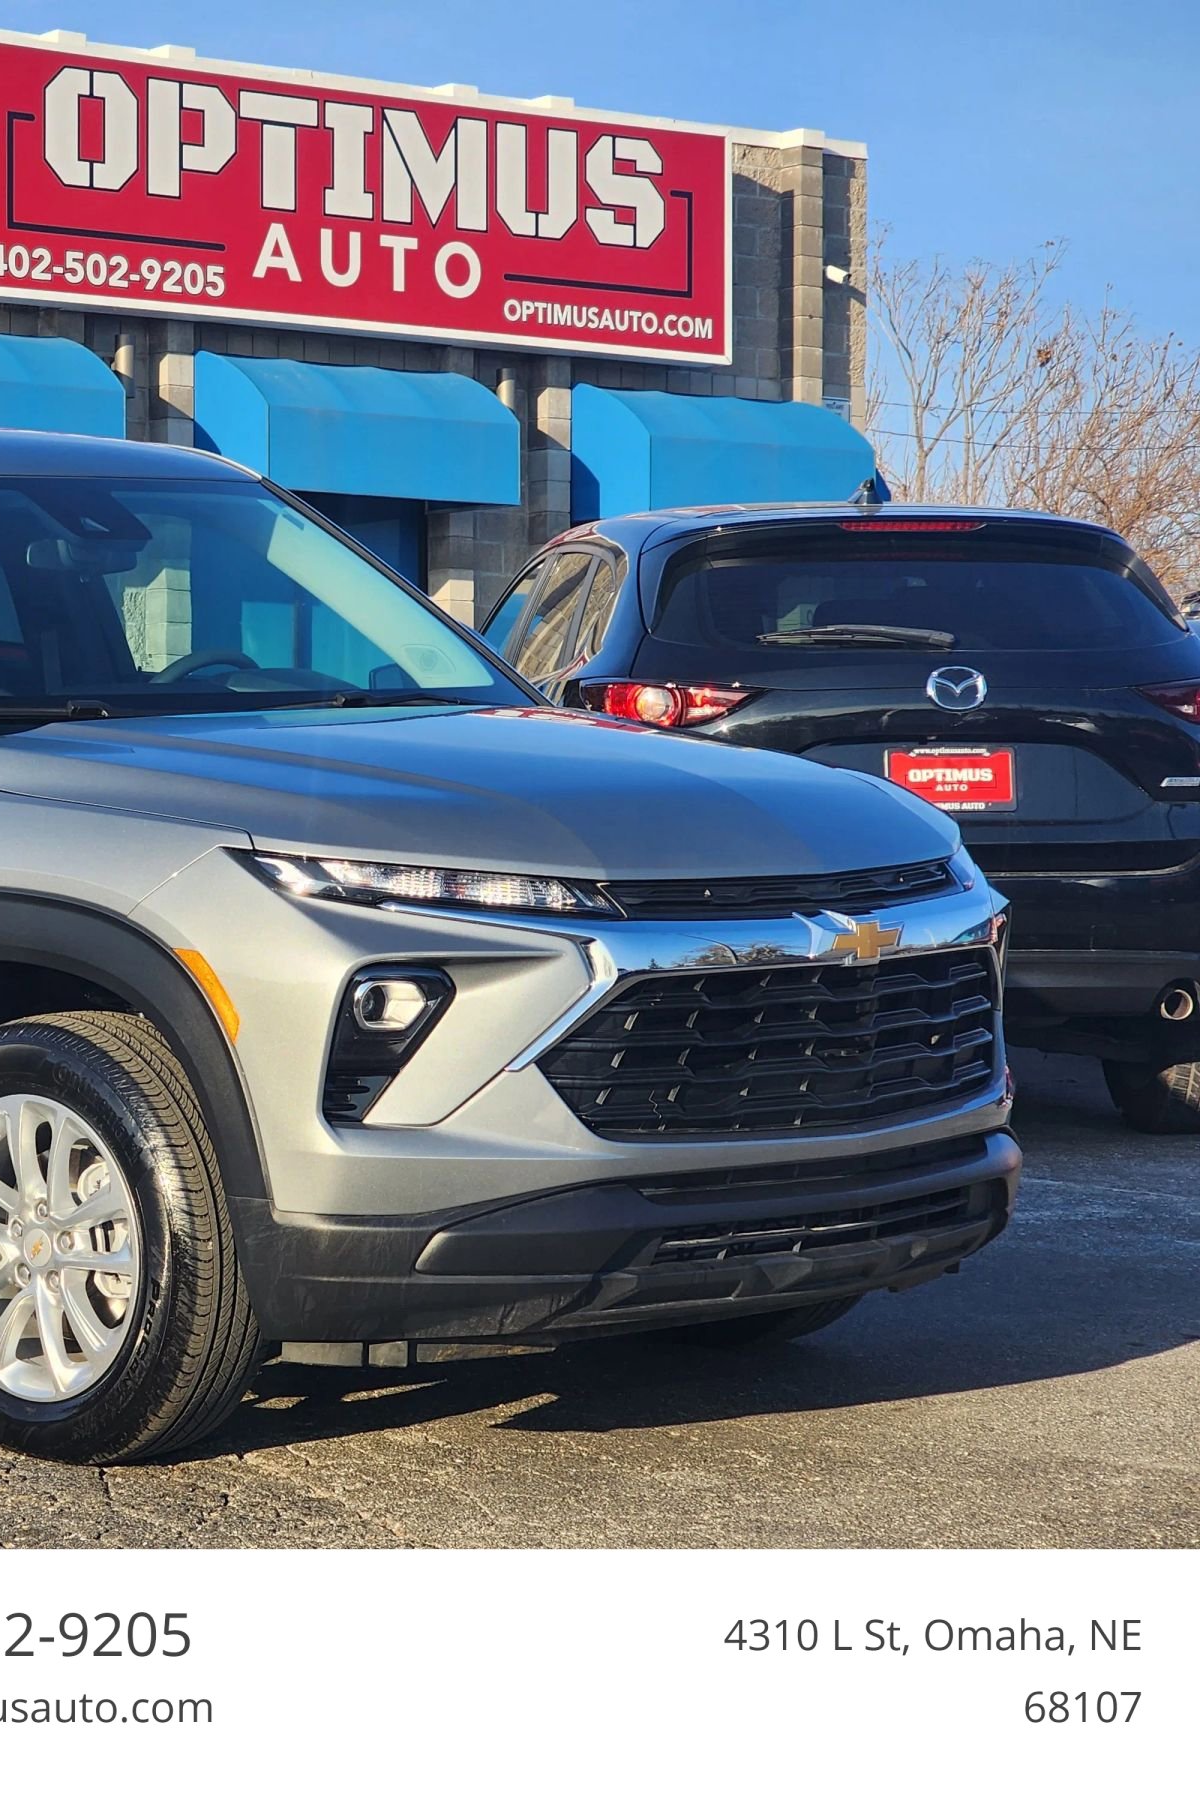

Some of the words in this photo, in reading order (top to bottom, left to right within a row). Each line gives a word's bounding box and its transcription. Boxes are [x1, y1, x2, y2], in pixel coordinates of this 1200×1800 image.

[43, 66, 666, 249] OPTIMUS
[252, 222, 482, 299] AUTO
[503, 298, 714, 341] OPTIMUSAUTO.COM
[907, 767, 993, 783] OPTIMUS
[935, 783, 969, 792] AUTO
[961, 802, 986, 810] AUTO
